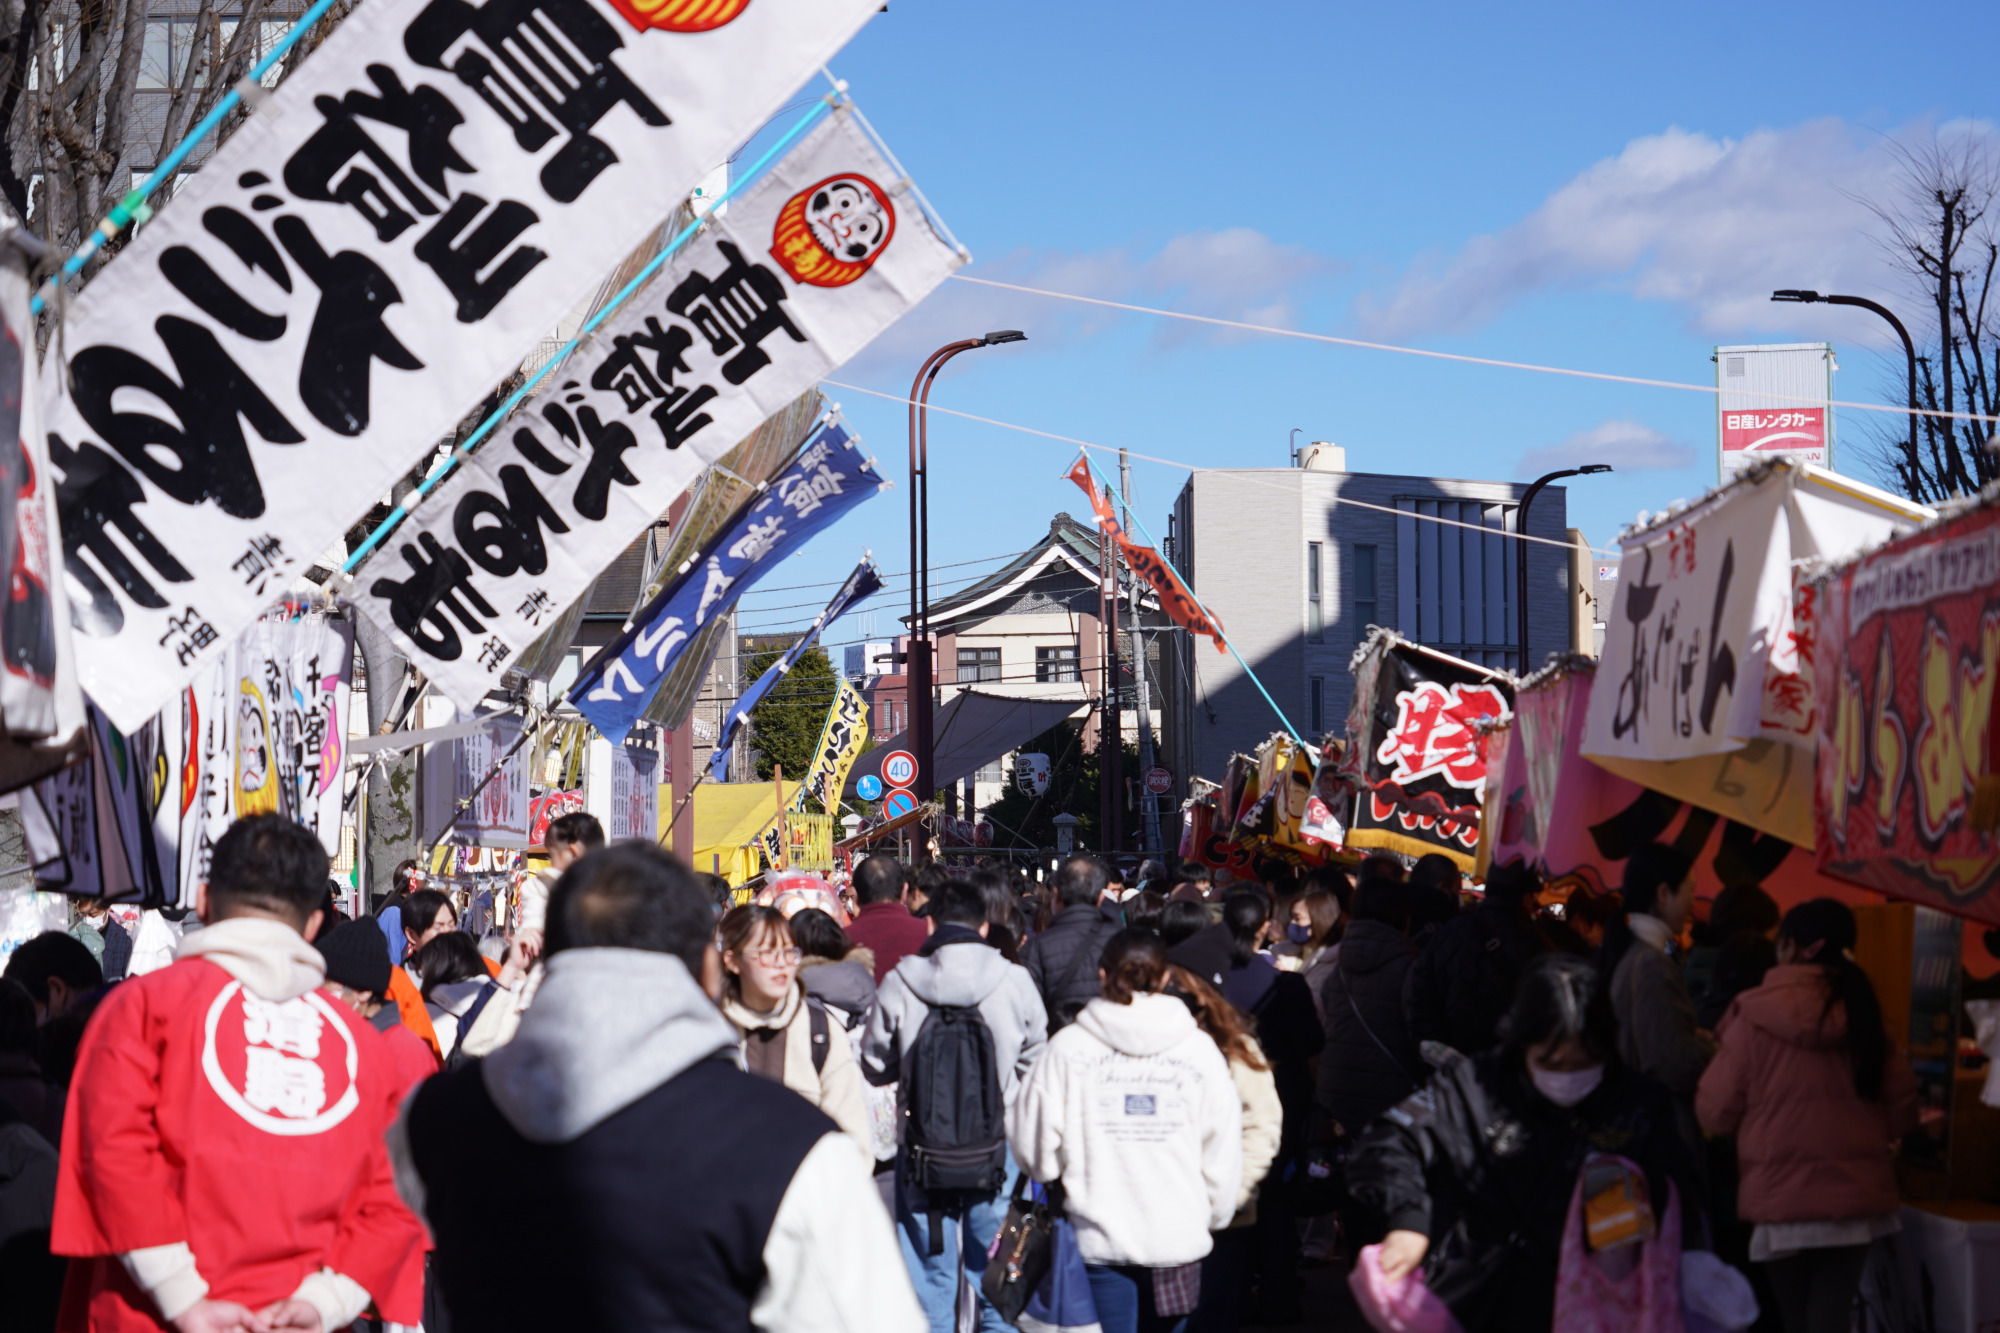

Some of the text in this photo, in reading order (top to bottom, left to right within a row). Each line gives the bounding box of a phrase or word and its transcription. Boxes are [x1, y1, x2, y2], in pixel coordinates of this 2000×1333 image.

[1727, 413, 1816, 429] 日産レンタカー
[891, 760, 911, 778] 40
[1149, 776, 1169, 786] 消火栓
